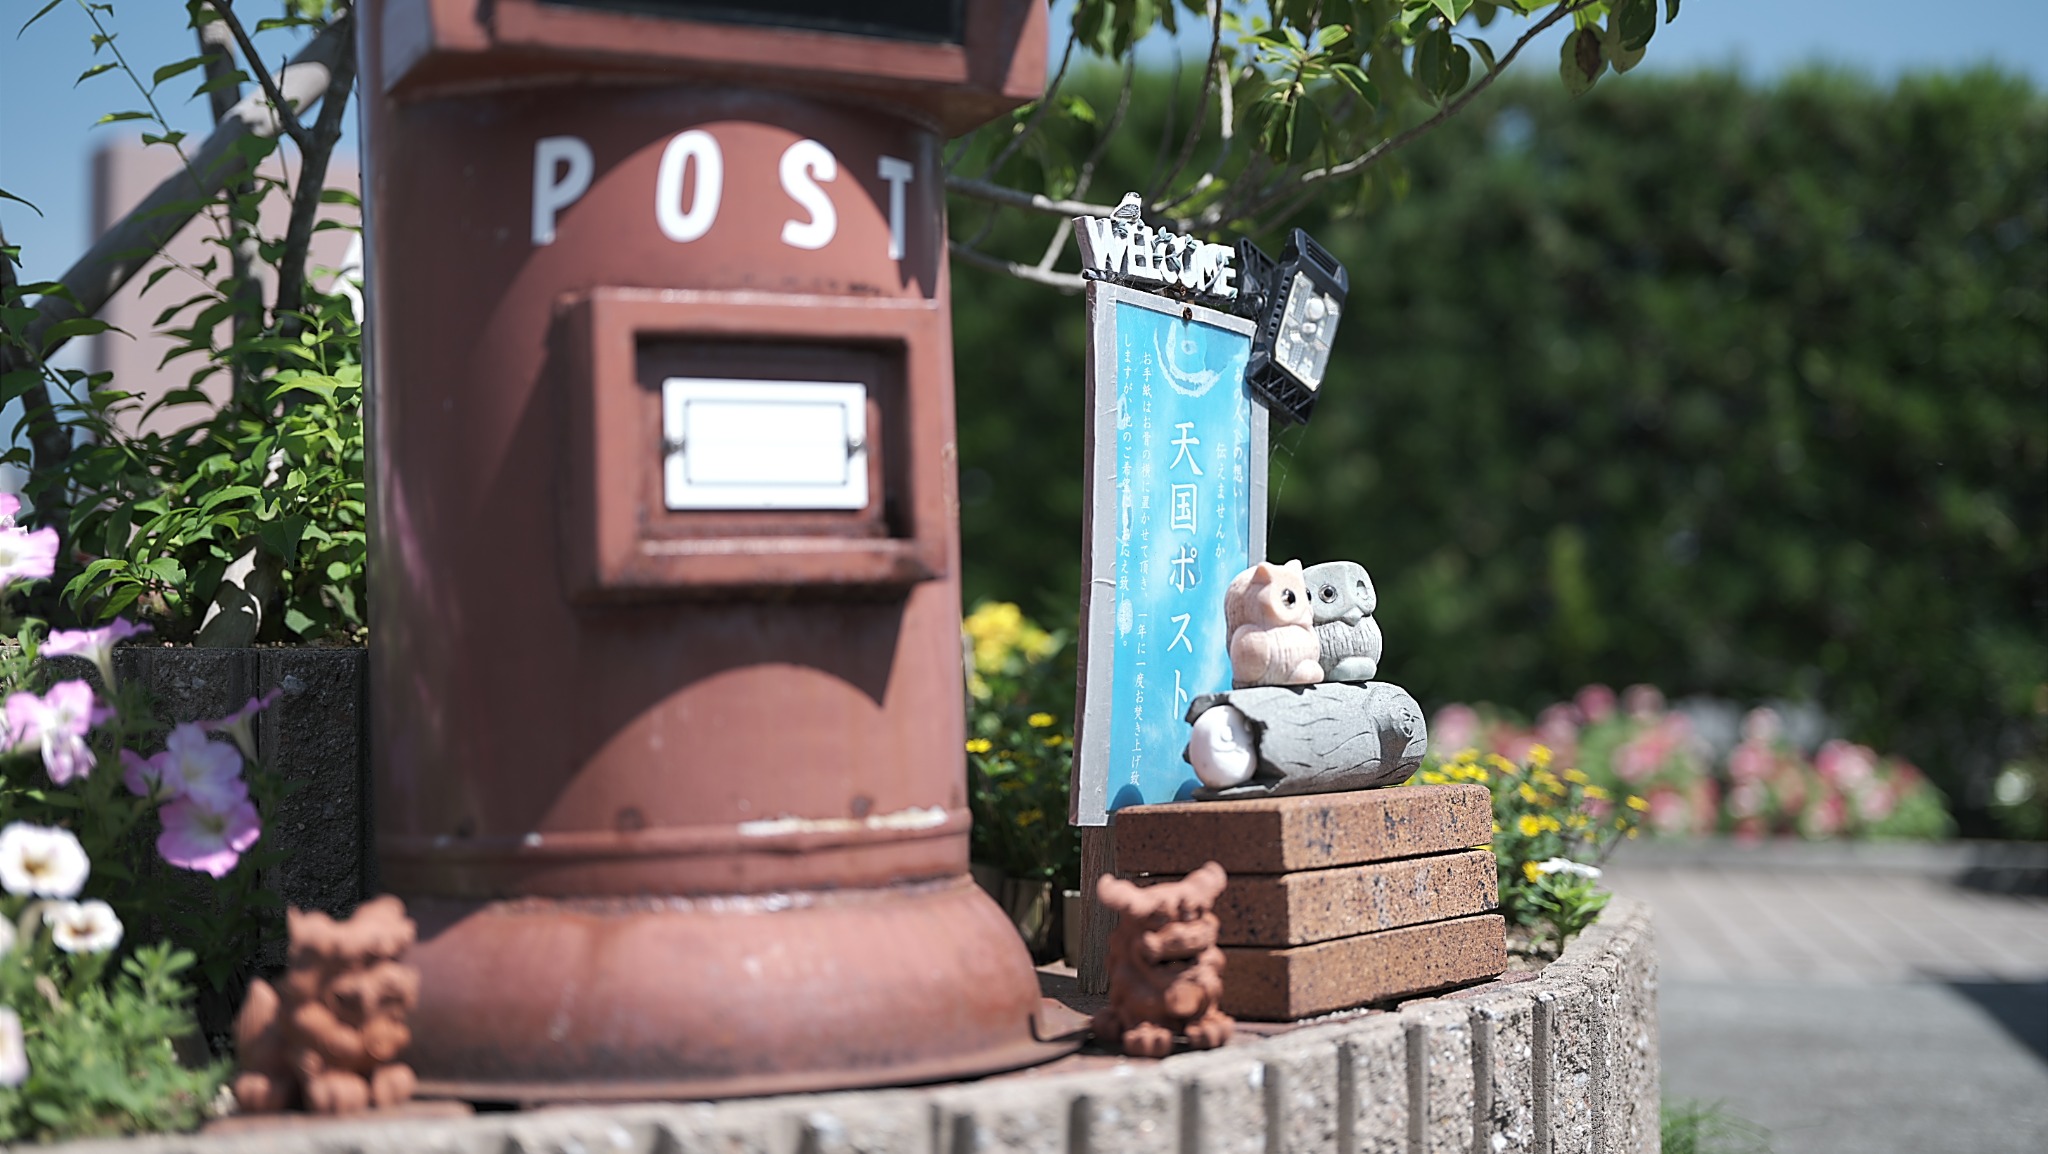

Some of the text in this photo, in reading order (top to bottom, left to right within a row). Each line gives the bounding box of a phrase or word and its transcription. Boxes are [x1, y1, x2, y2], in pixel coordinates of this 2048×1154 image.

[531, 129, 914, 260] POST
[1074, 214, 1238, 299] WELCOME
[1215, 442, 1228, 569] 伝えませんか。
[1166, 421, 1204, 720] 天国ポスト
